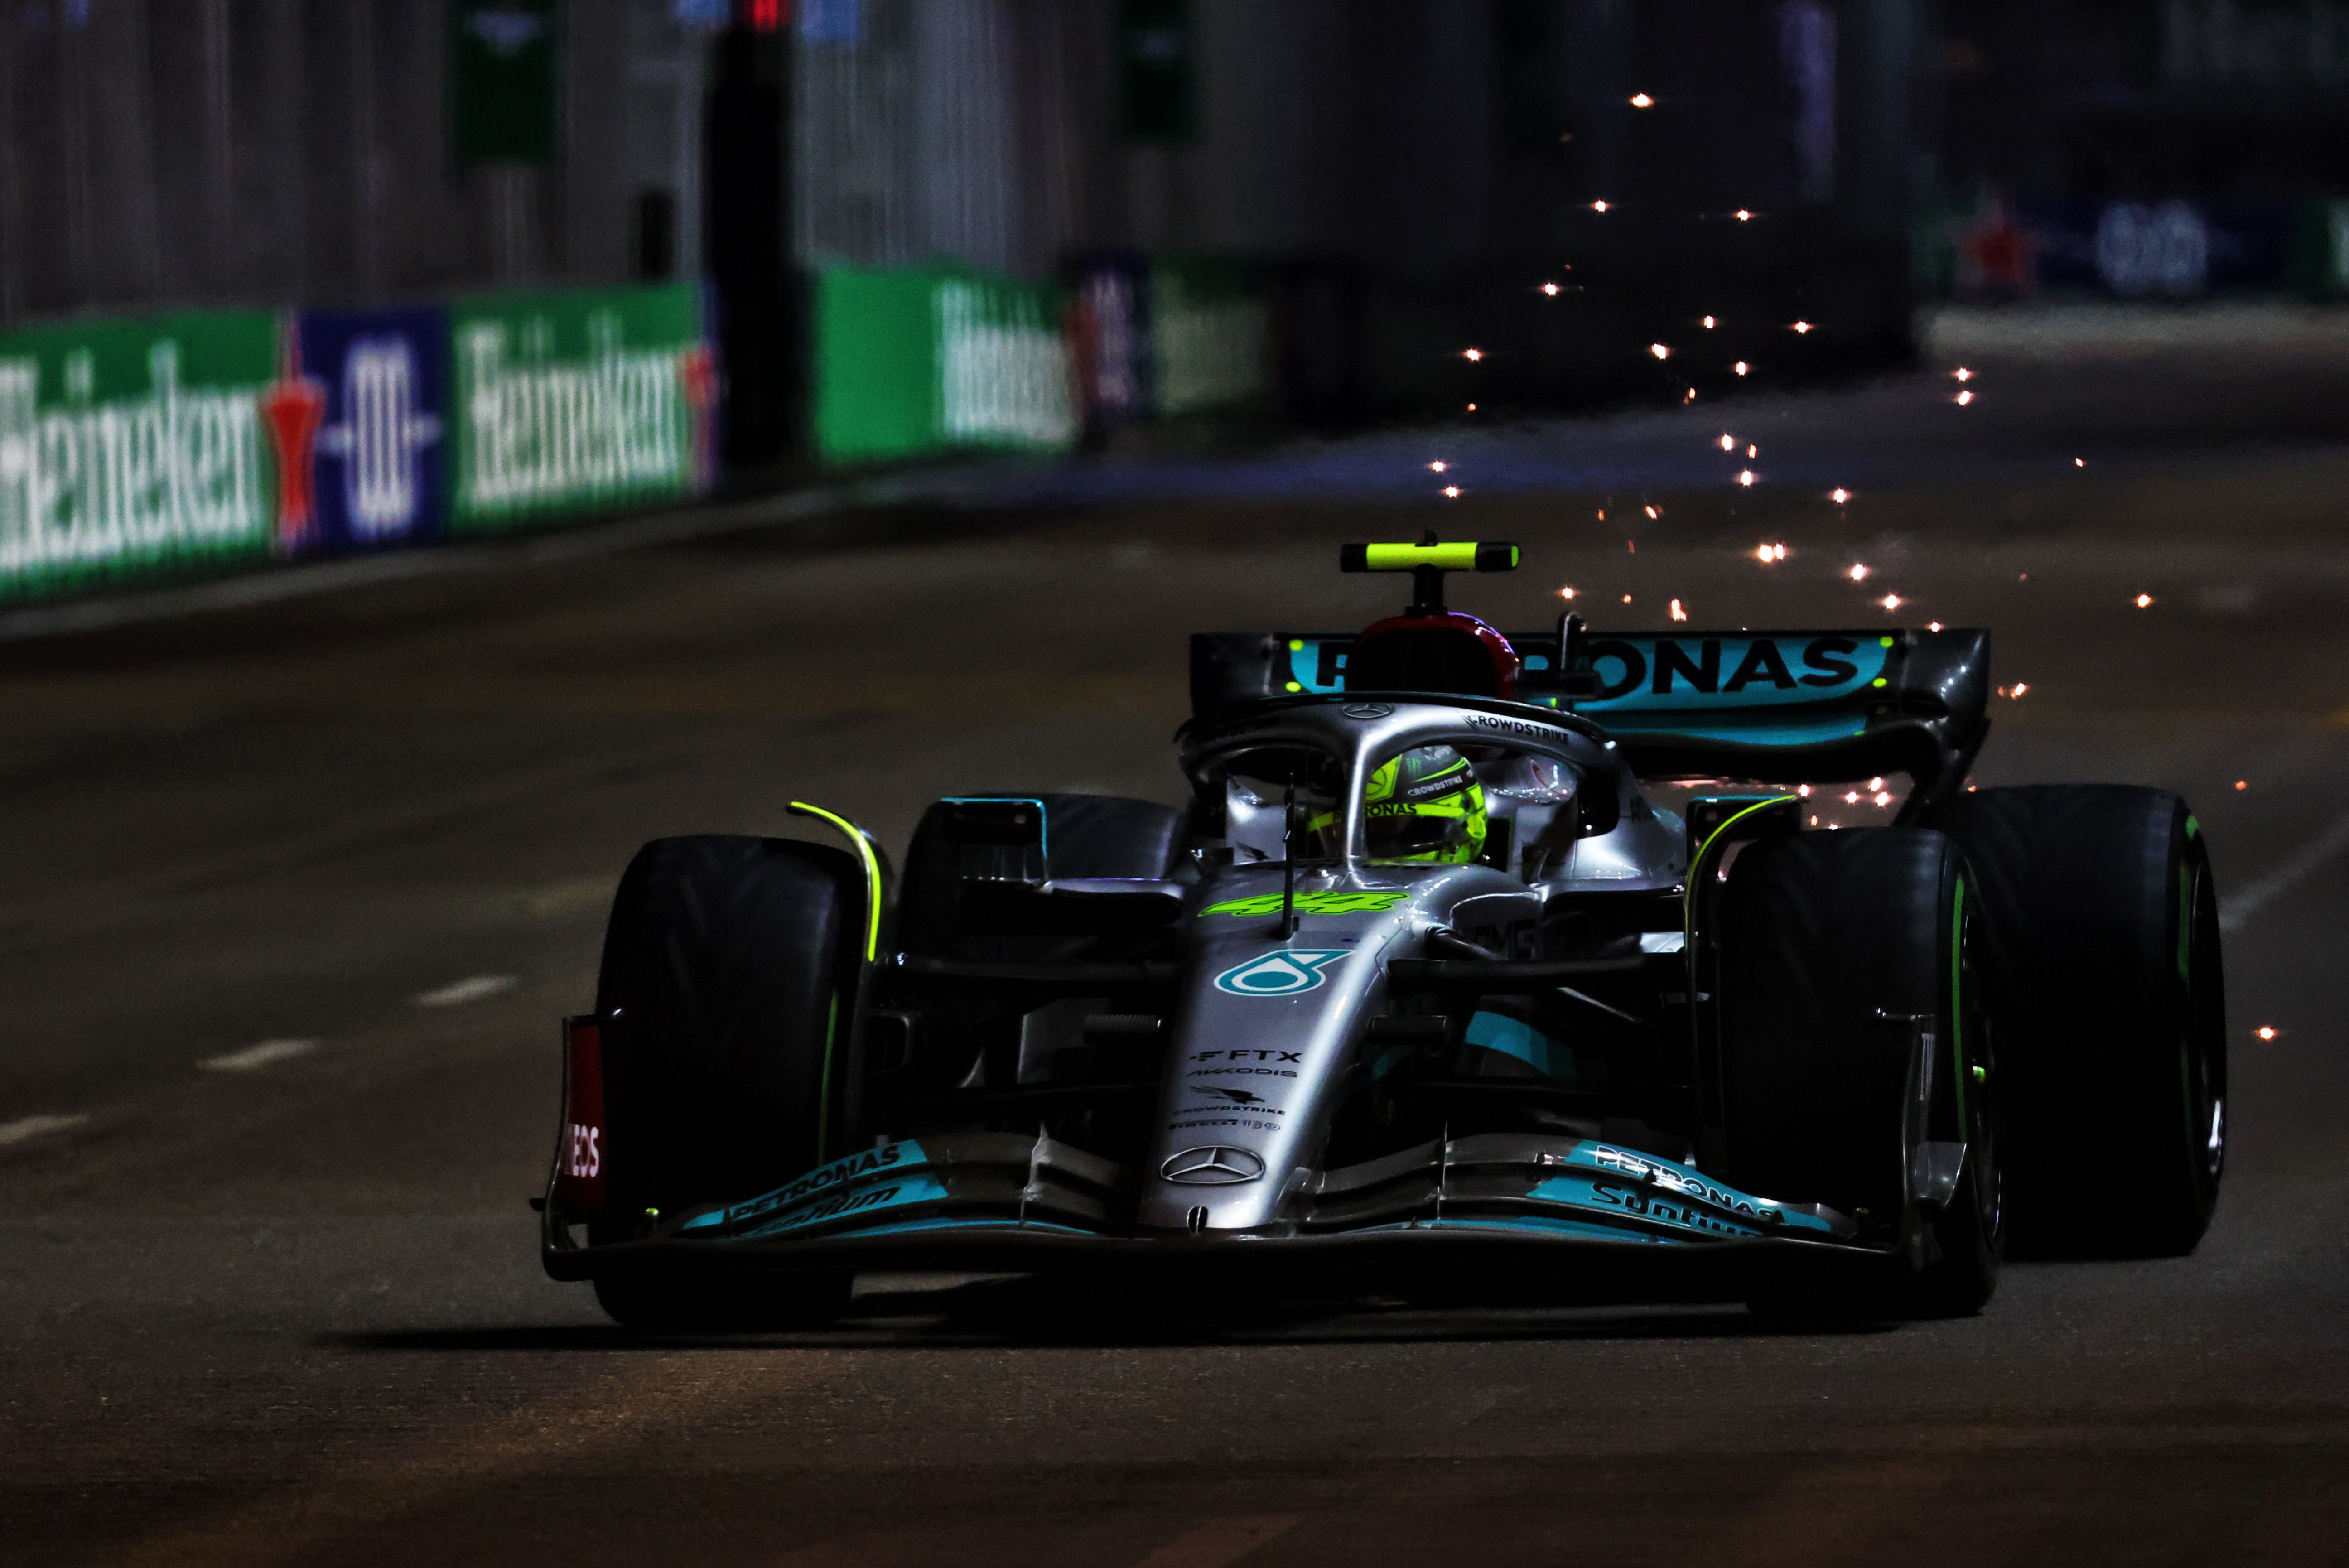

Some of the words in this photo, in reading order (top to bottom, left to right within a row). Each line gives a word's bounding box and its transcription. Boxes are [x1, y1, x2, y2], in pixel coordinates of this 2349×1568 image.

[1317, 638, 1859, 700] PONAS
[1468, 715, 1569, 745] CROWDSTRIKE
[1408, 775, 1463, 796] CROWDSTRIKE
[1229, 1050, 1302, 1063] FTX
[1173, 1105, 1286, 1115] CROWDSTRIKE
[564, 1123, 599, 1178] EOS
[733, 1145, 900, 1220] PETRONAS
[1591, 1182, 1760, 1236] Synti
